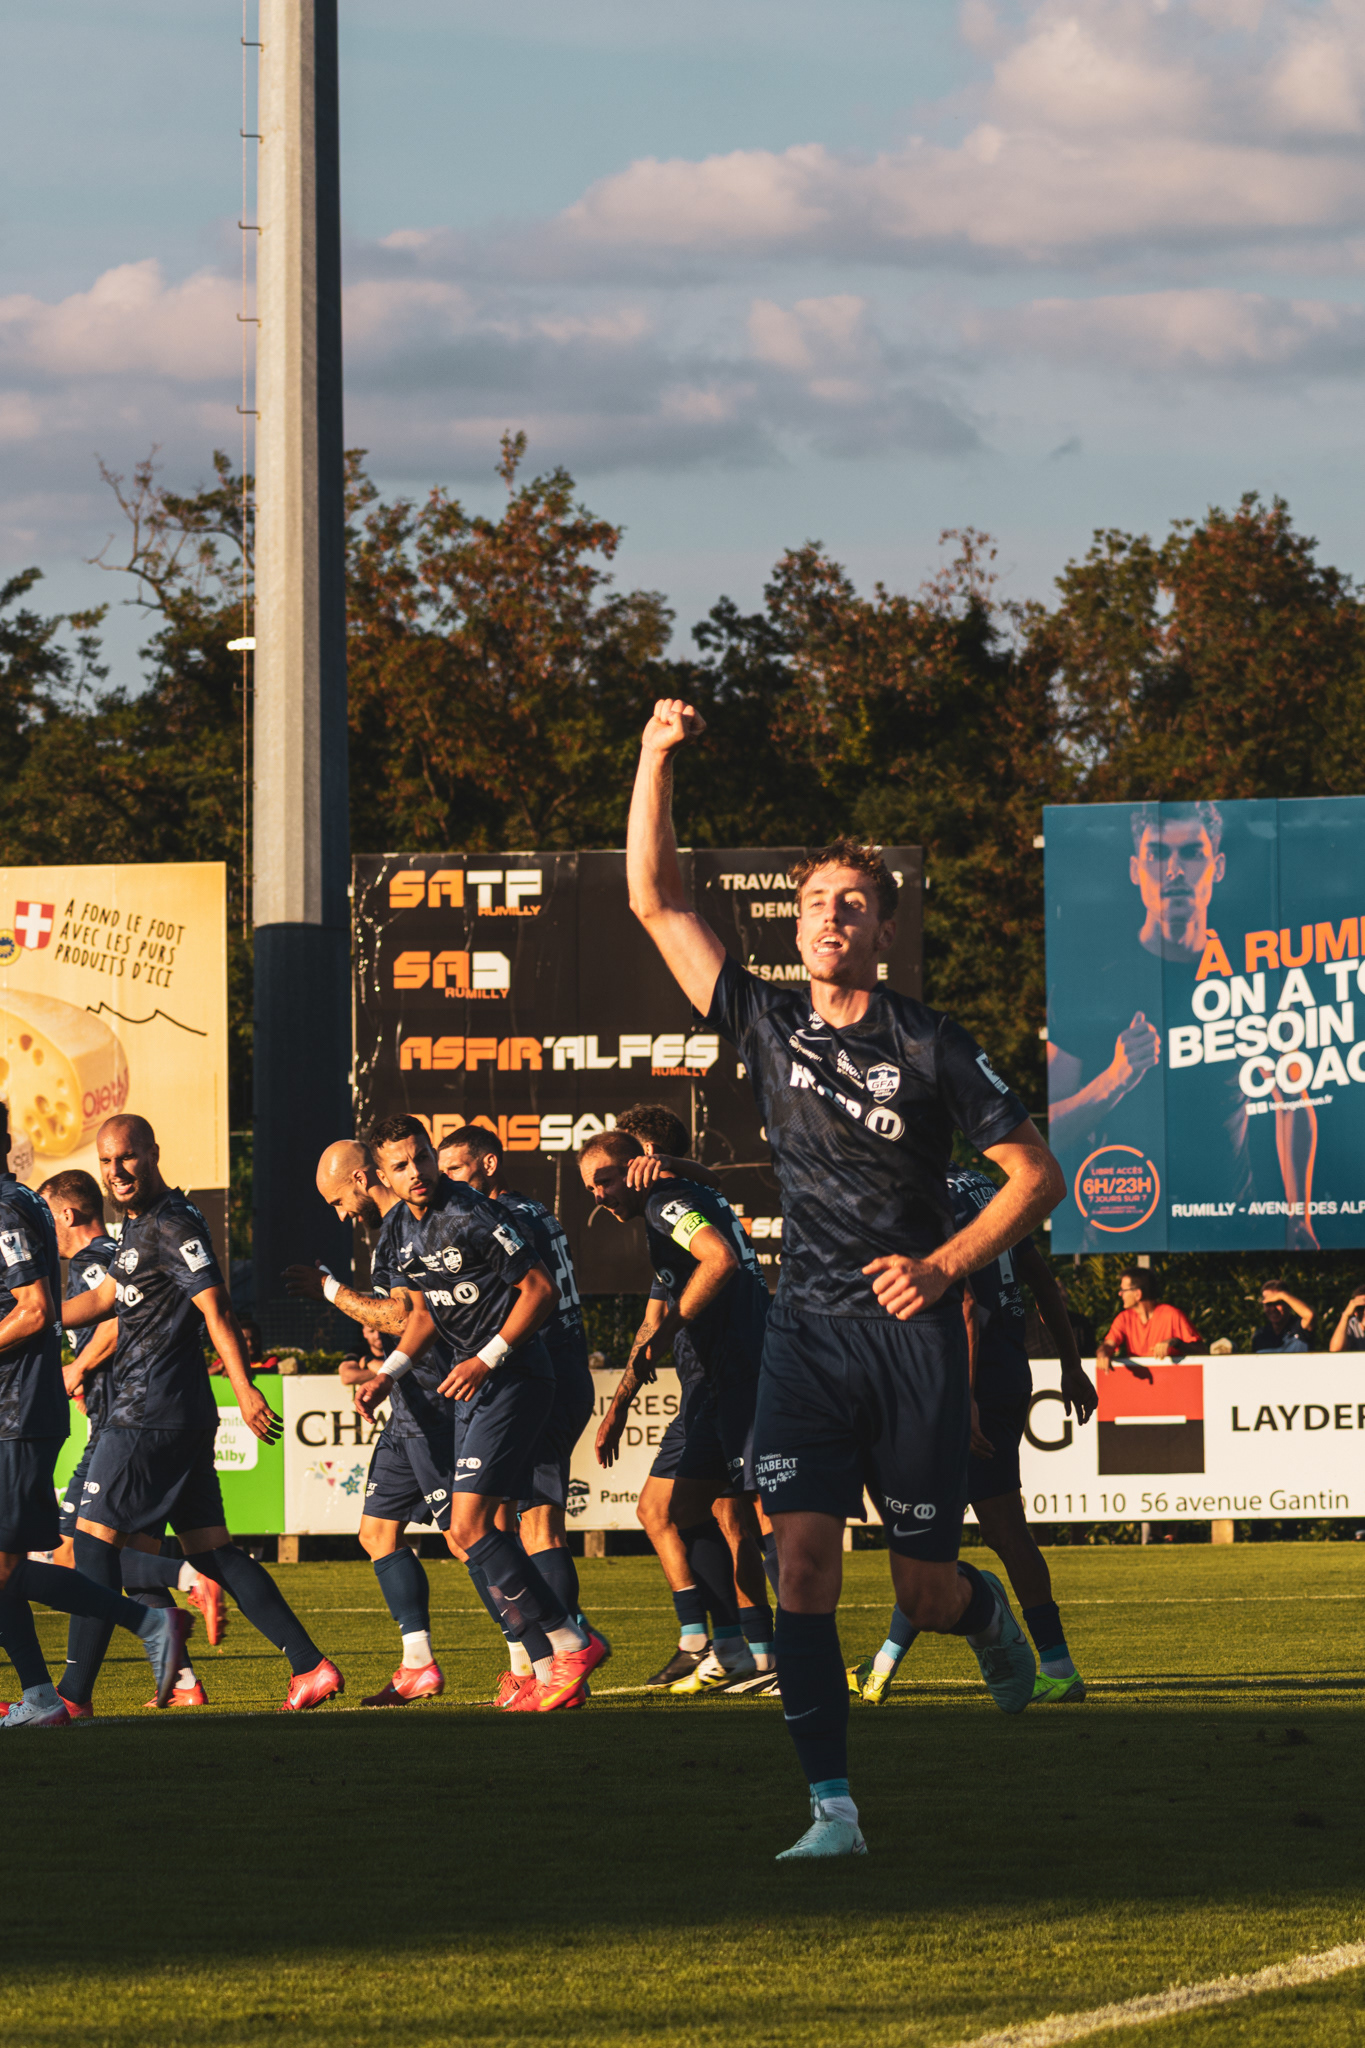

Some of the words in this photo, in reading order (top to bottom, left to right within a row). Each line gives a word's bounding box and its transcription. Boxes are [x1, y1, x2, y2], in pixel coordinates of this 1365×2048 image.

[389, 869, 542, 908] SATP
[718, 873, 799, 891] TRAVAU
[478, 905, 541, 916] RUMILLY
[751, 903, 800, 918] DEMO
[64, 897, 75, 918] A
[81, 902, 120, 928] FOND
[126, 912, 142, 933] LE
[147, 918, 186, 945] FOOT
[59, 920, 99, 947] AVEC
[105, 931, 132, 955] LES
[138, 940, 176, 966] PURS
[1195, 928, 1233, 981] À
[54, 943, 126, 977] PRODUITS
[132, 961, 173, 988] D'ICI
[445, 987, 509, 999] RUMILLY
[1191, 972, 1266, 1022] ON
[1277, 967, 1316, 1011] A
[1168, 1001, 1355, 1069] BESOIN
[651, 1067, 708, 1077] RUMILLY
[871, 1080, 895, 1089] GFA
[1091, 1167, 1114, 1176] LIBRE
[1116, 1166, 1143, 1175] ACCÈS
[1082, 1177, 1152, 1195] 6H/23H
[1088, 1195, 1094, 1203] 7
[1095, 1195, 1122, 1203] JOURS
[1123, 1194, 1141, 1202] SUR
[1142, 1194, 1147, 1202] 7
[1171, 1202, 1236, 1217] RUMILLY
[1247, 1201, 1304, 1216] AVENUE
[1307, 1200, 1337, 1215] DES
[1340, 1200, 1365, 1214] ALP
[296, 1410, 389, 1448] CHA
[220, 1432, 236, 1444] du
[215, 1450, 246, 1464] Alby
[600, 1489, 639, 1503] Parte
[1099, 1492, 1126, 1514] 10
[1141, 1491, 1169, 1513] 56
[1175, 1494, 1262, 1513] avenue
[1268, 1488, 1350, 1512] Gantin
